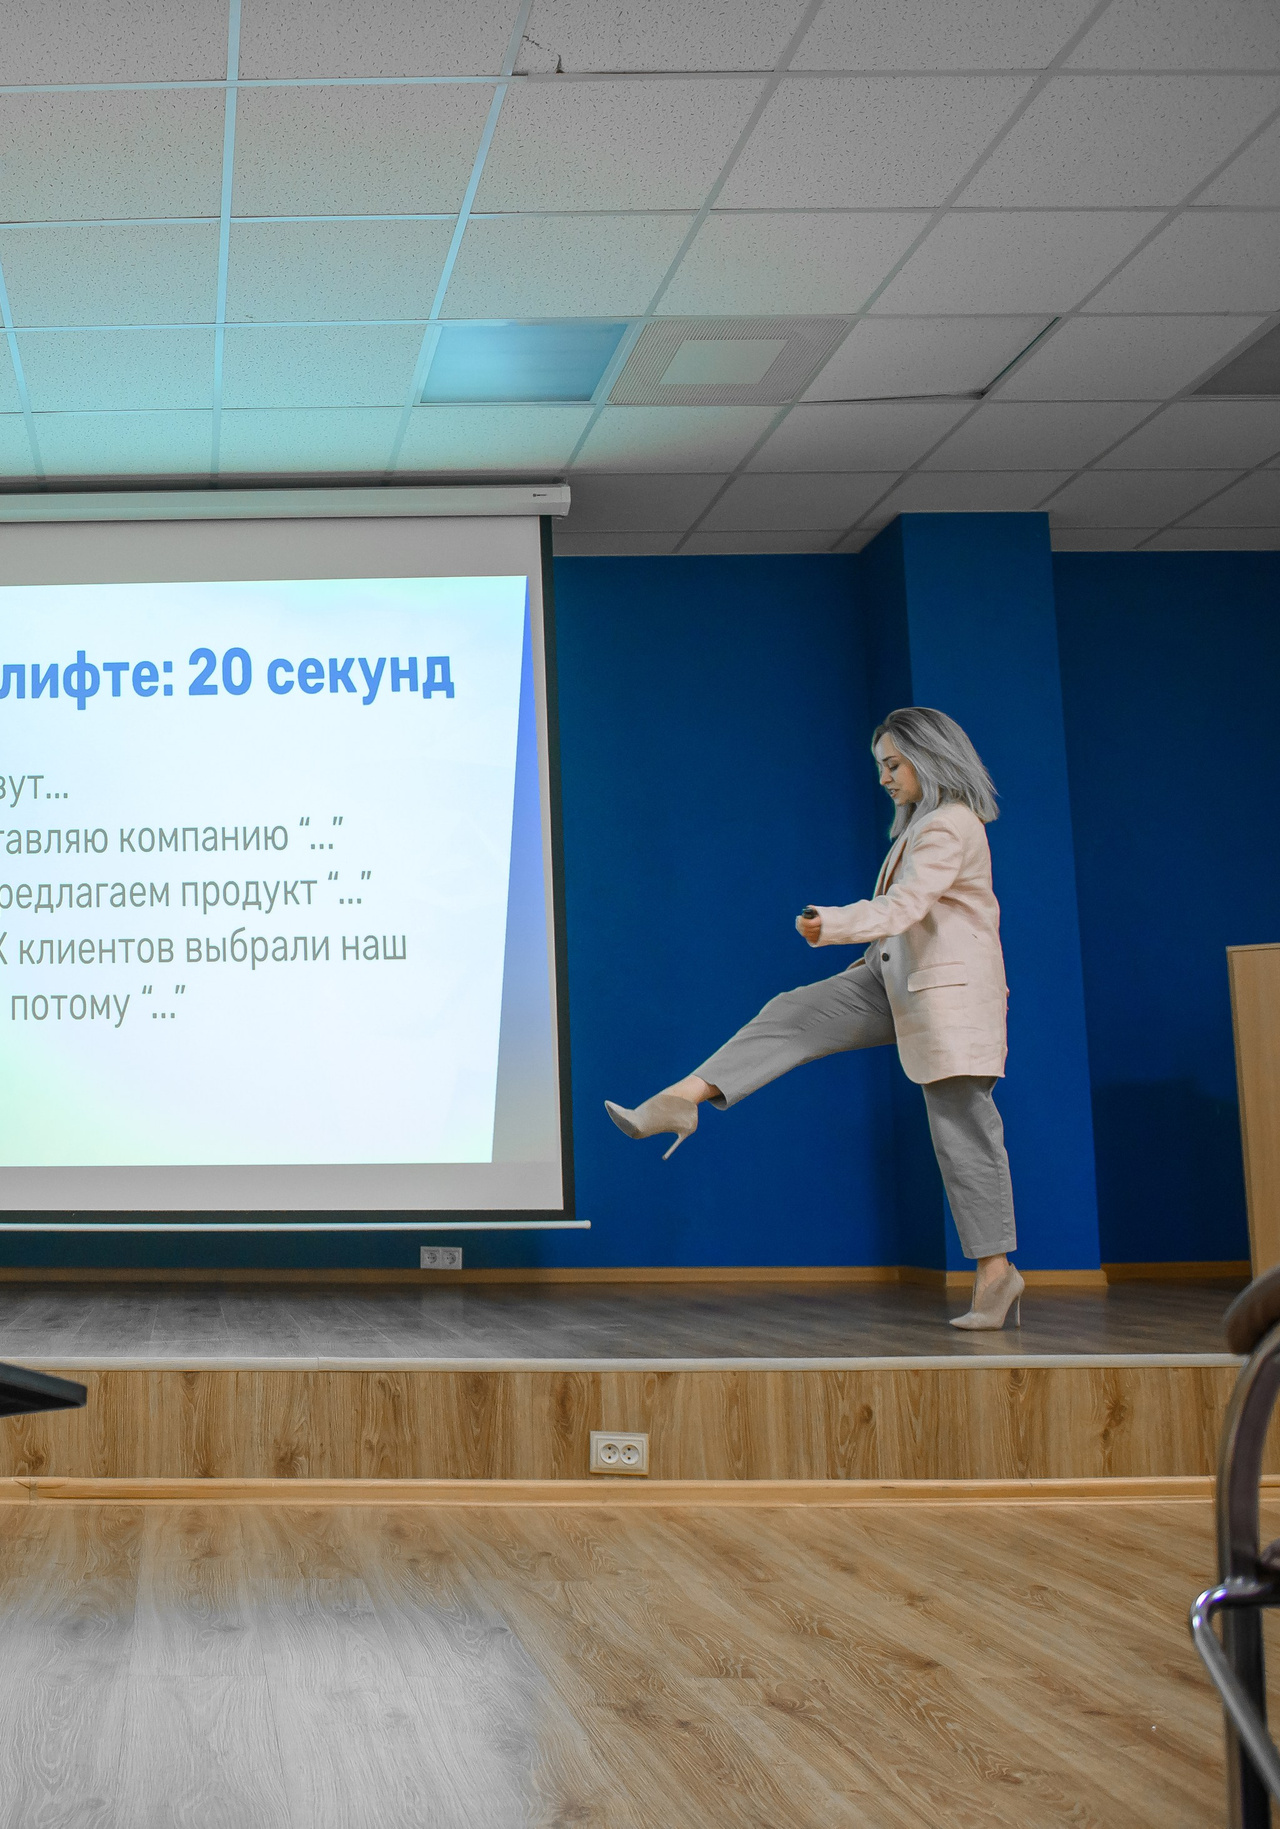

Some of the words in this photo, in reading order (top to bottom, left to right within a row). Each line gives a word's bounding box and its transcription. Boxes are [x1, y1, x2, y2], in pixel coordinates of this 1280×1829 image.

[187, 645, 253, 698] 20
[266, 654, 456, 707] секунд
[119, 824, 289, 854] компанию
[181, 879, 318, 916] продукт
[18, 937, 175, 966] клиентов
[185, 926, 330, 971] выбрали
[341, 934, 407, 962] наш
[11, 993, 131, 1029] потому
